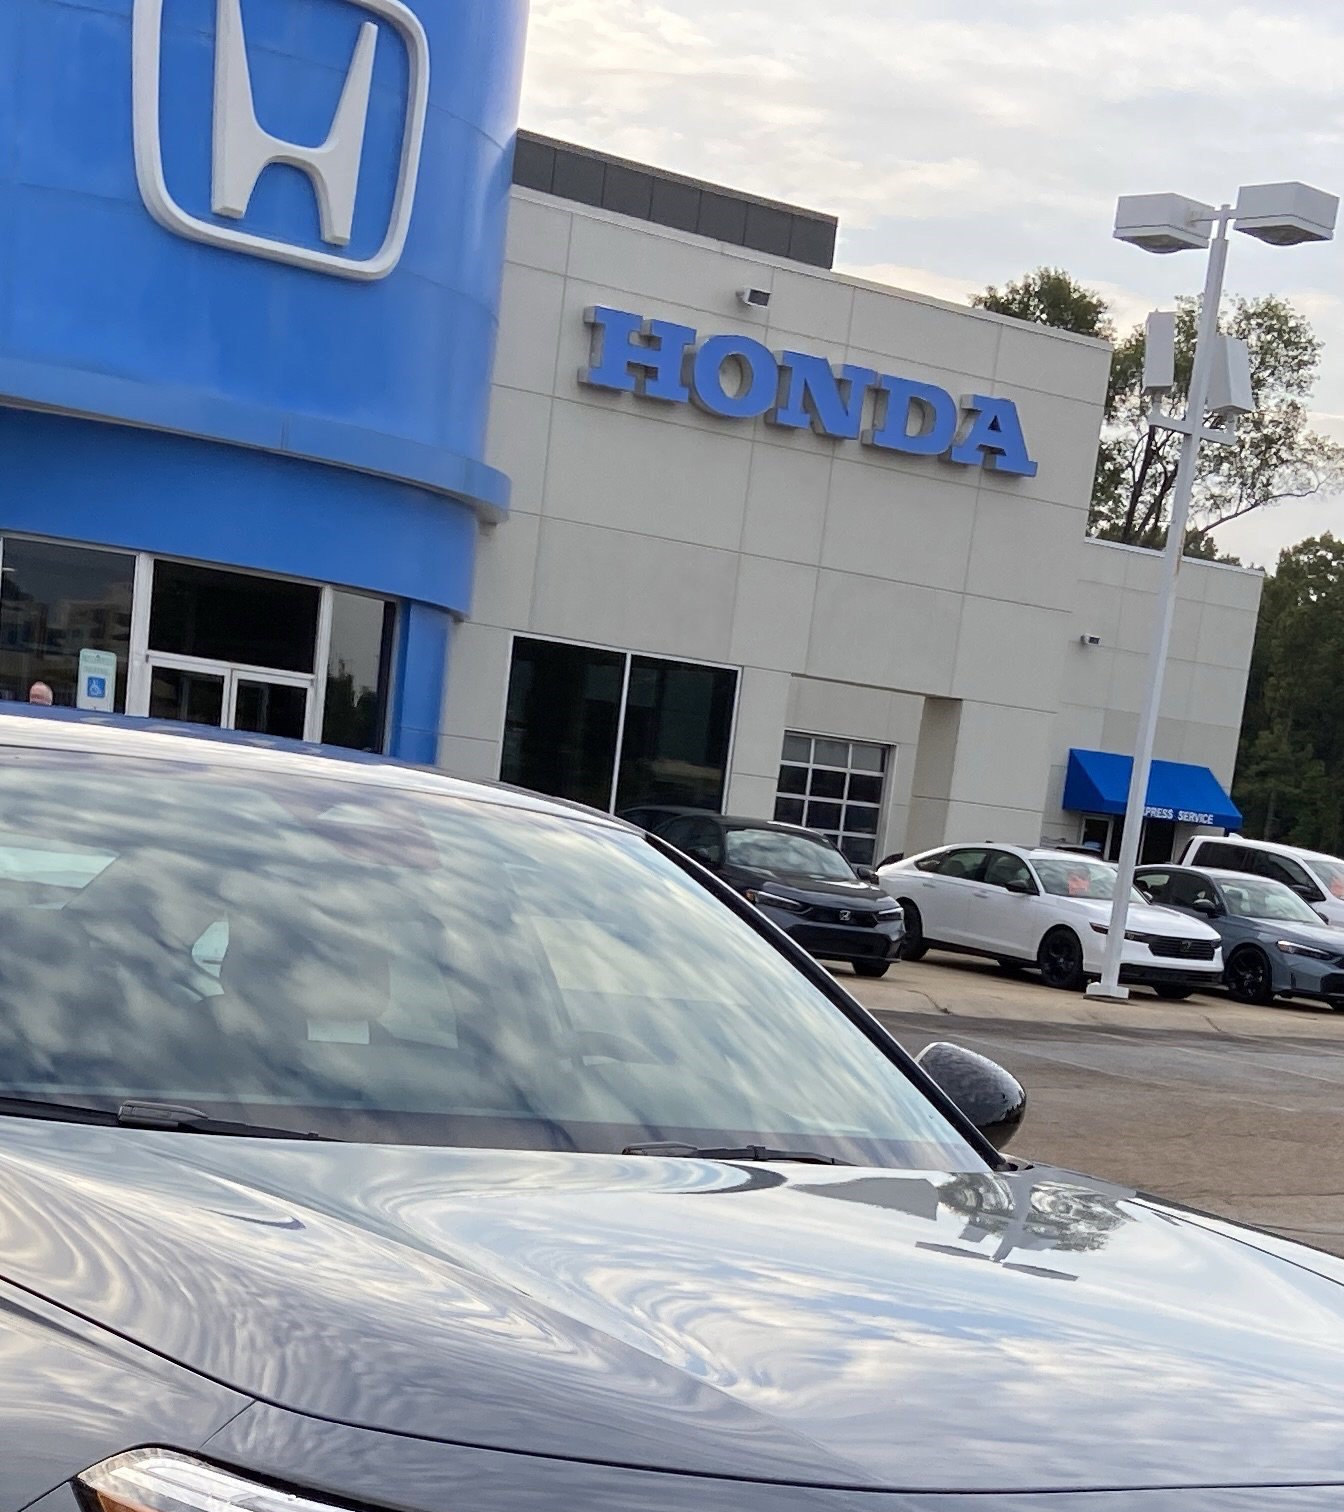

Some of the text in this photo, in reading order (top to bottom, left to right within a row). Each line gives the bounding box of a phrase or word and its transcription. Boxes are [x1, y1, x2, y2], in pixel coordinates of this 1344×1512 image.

[579, 305, 1038, 477] HONDA
[1144, 806, 1214, 825] PRESS SERVICE
